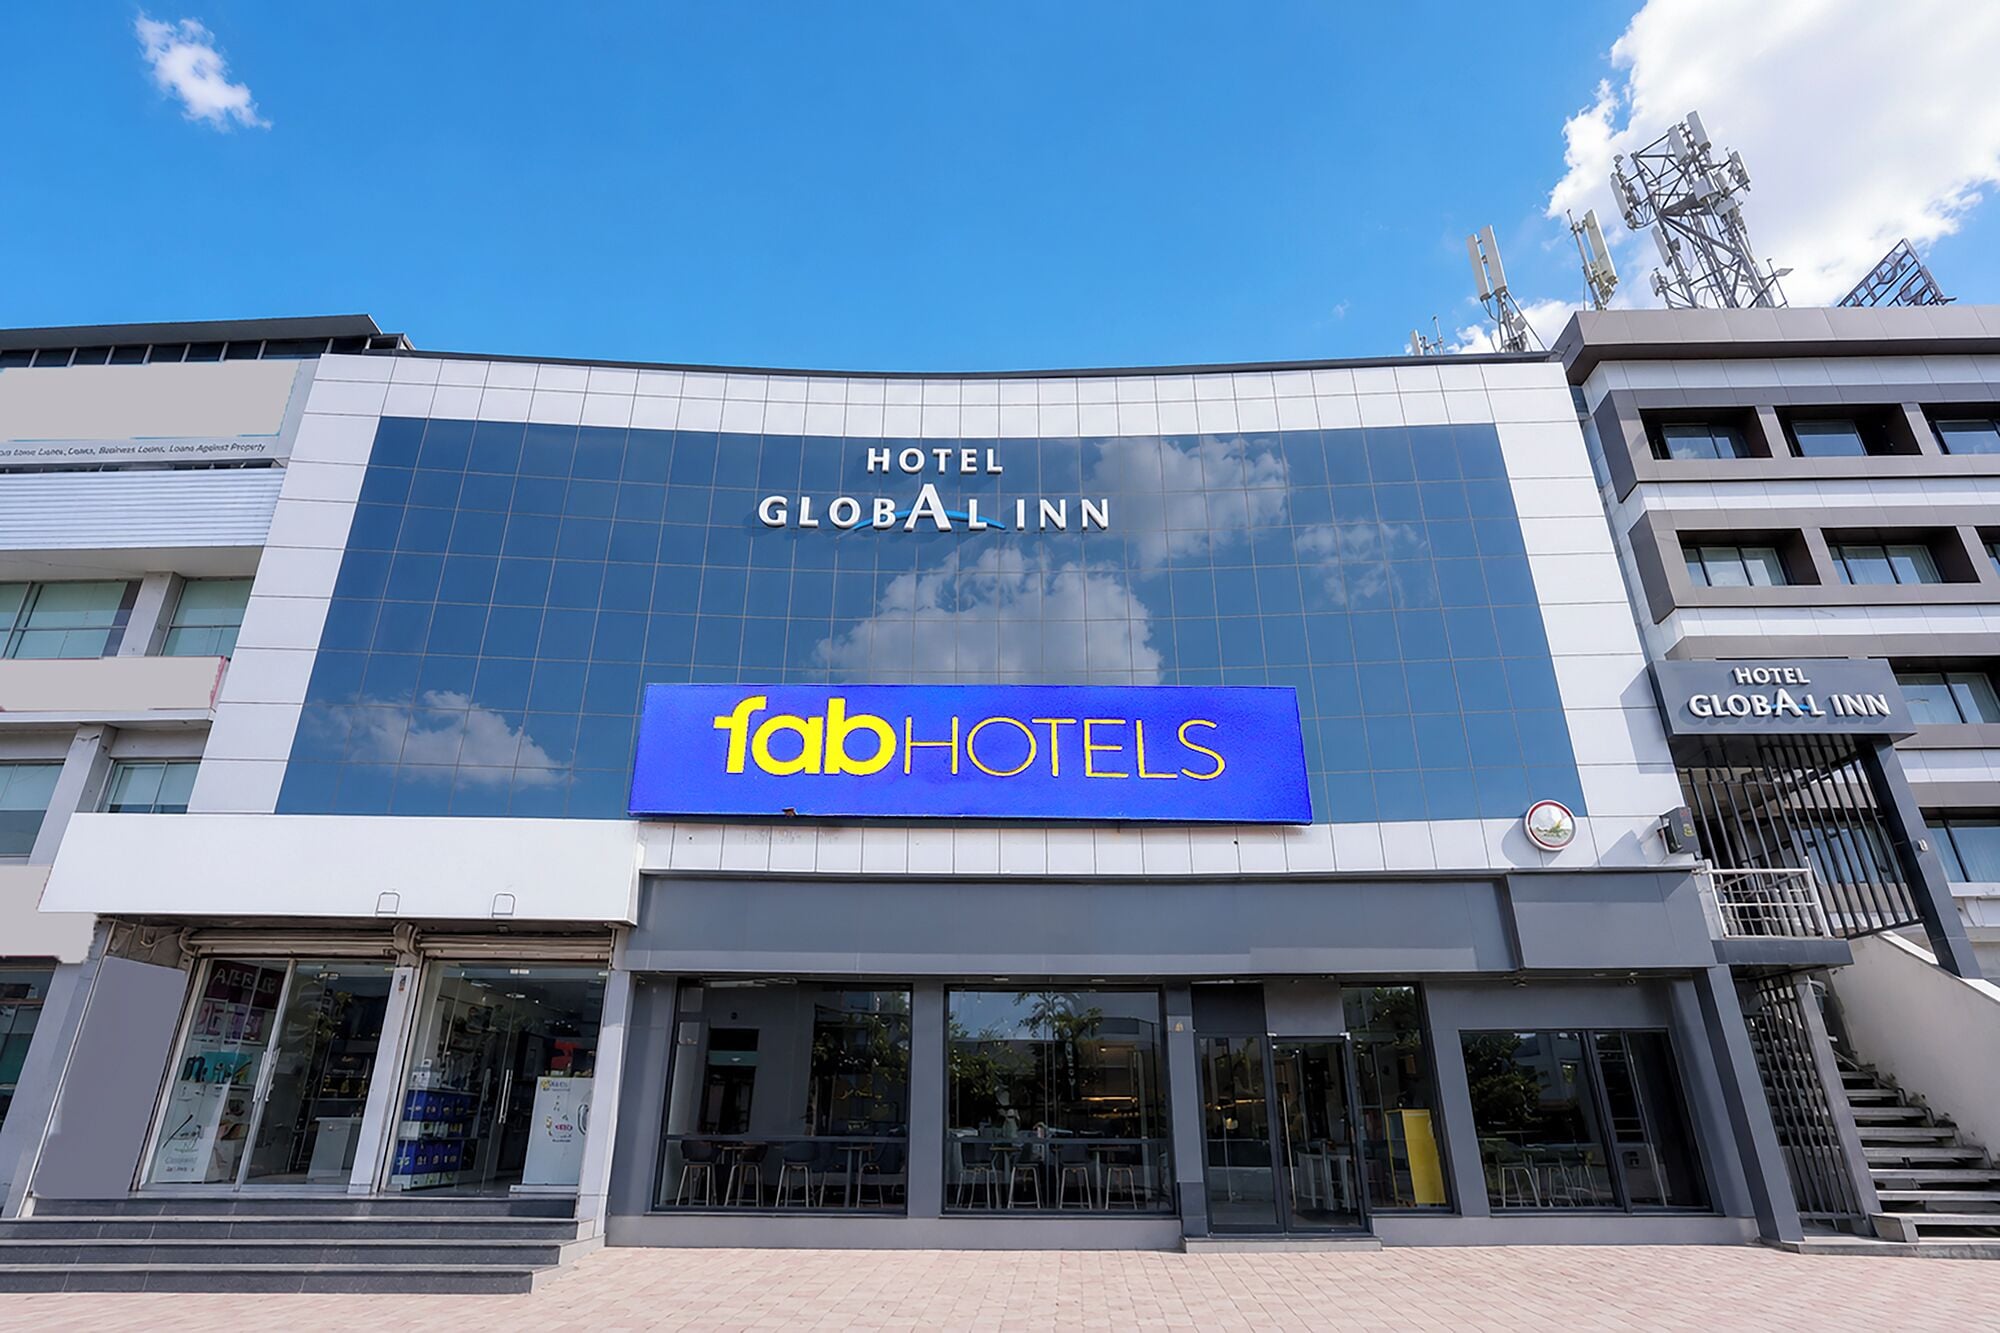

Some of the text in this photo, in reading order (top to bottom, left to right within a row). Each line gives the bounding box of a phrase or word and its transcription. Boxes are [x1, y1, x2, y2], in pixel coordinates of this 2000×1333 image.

[230, 442, 267, 453] Property
[866, 447, 1003, 474] HOTEL
[758, 483, 1110, 532] GLOBAL INN
[1733, 667, 1811, 685] HOTEL
[1688, 688, 1892, 717] GLOBAL INN
